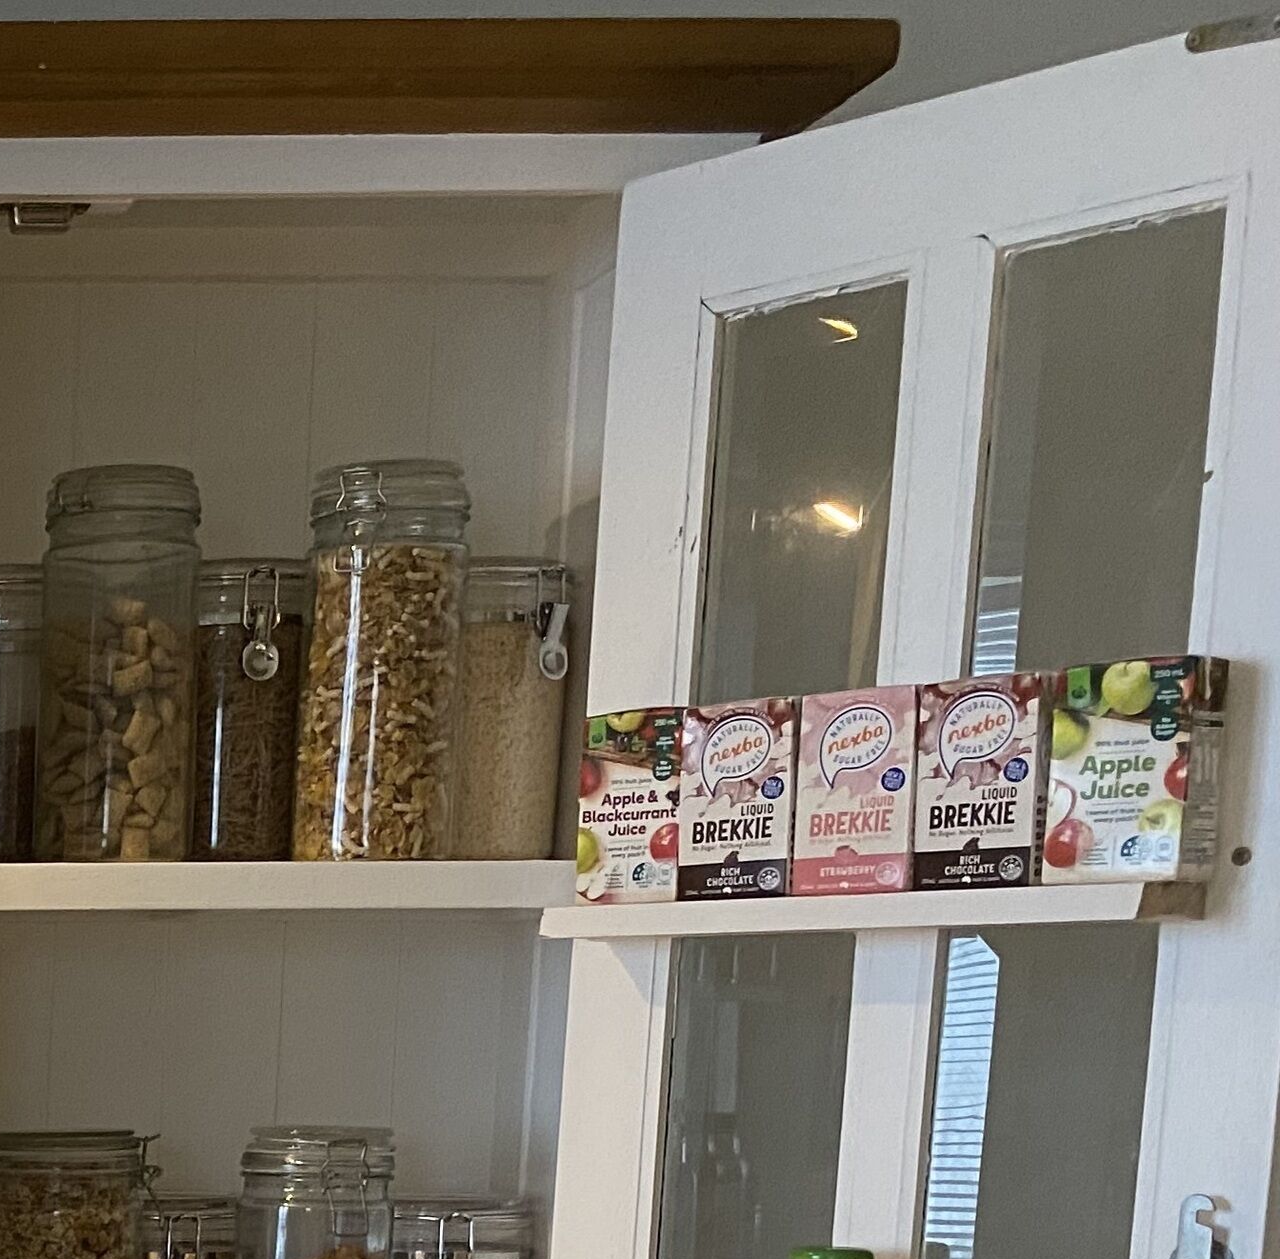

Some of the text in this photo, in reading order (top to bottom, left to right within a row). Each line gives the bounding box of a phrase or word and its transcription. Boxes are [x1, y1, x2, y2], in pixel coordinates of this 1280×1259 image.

[947, 713, 1006, 743] nexba
[828, 726, 883, 754] nexba
[709, 736, 763, 765] nexba
[1079, 755, 1156, 779] Apple
[982, 787, 1017, 800] LIQUID
[1081, 781, 1149, 800] Juice
[601, 791, 658, 809] Apple &
[860, 795, 894, 807] LIQUID
[582, 808, 677, 823] Blackcurrant
[741, 803, 774, 816] LIQUID
[929, 801, 1017, 829] BREKKIE
[608, 825, 646, 836] Juice
[692, 817, 773, 844] BREKKIE
[810, 809, 893, 837] BREKKIE
[960, 855, 980, 865] RICH
[721, 868, 740, 876] RICH
[820, 865, 875, 877] STRAWBERRY
[945, 864, 994, 876] CHOCOLATE
[707, 875, 753, 887] CHOCOLATE
